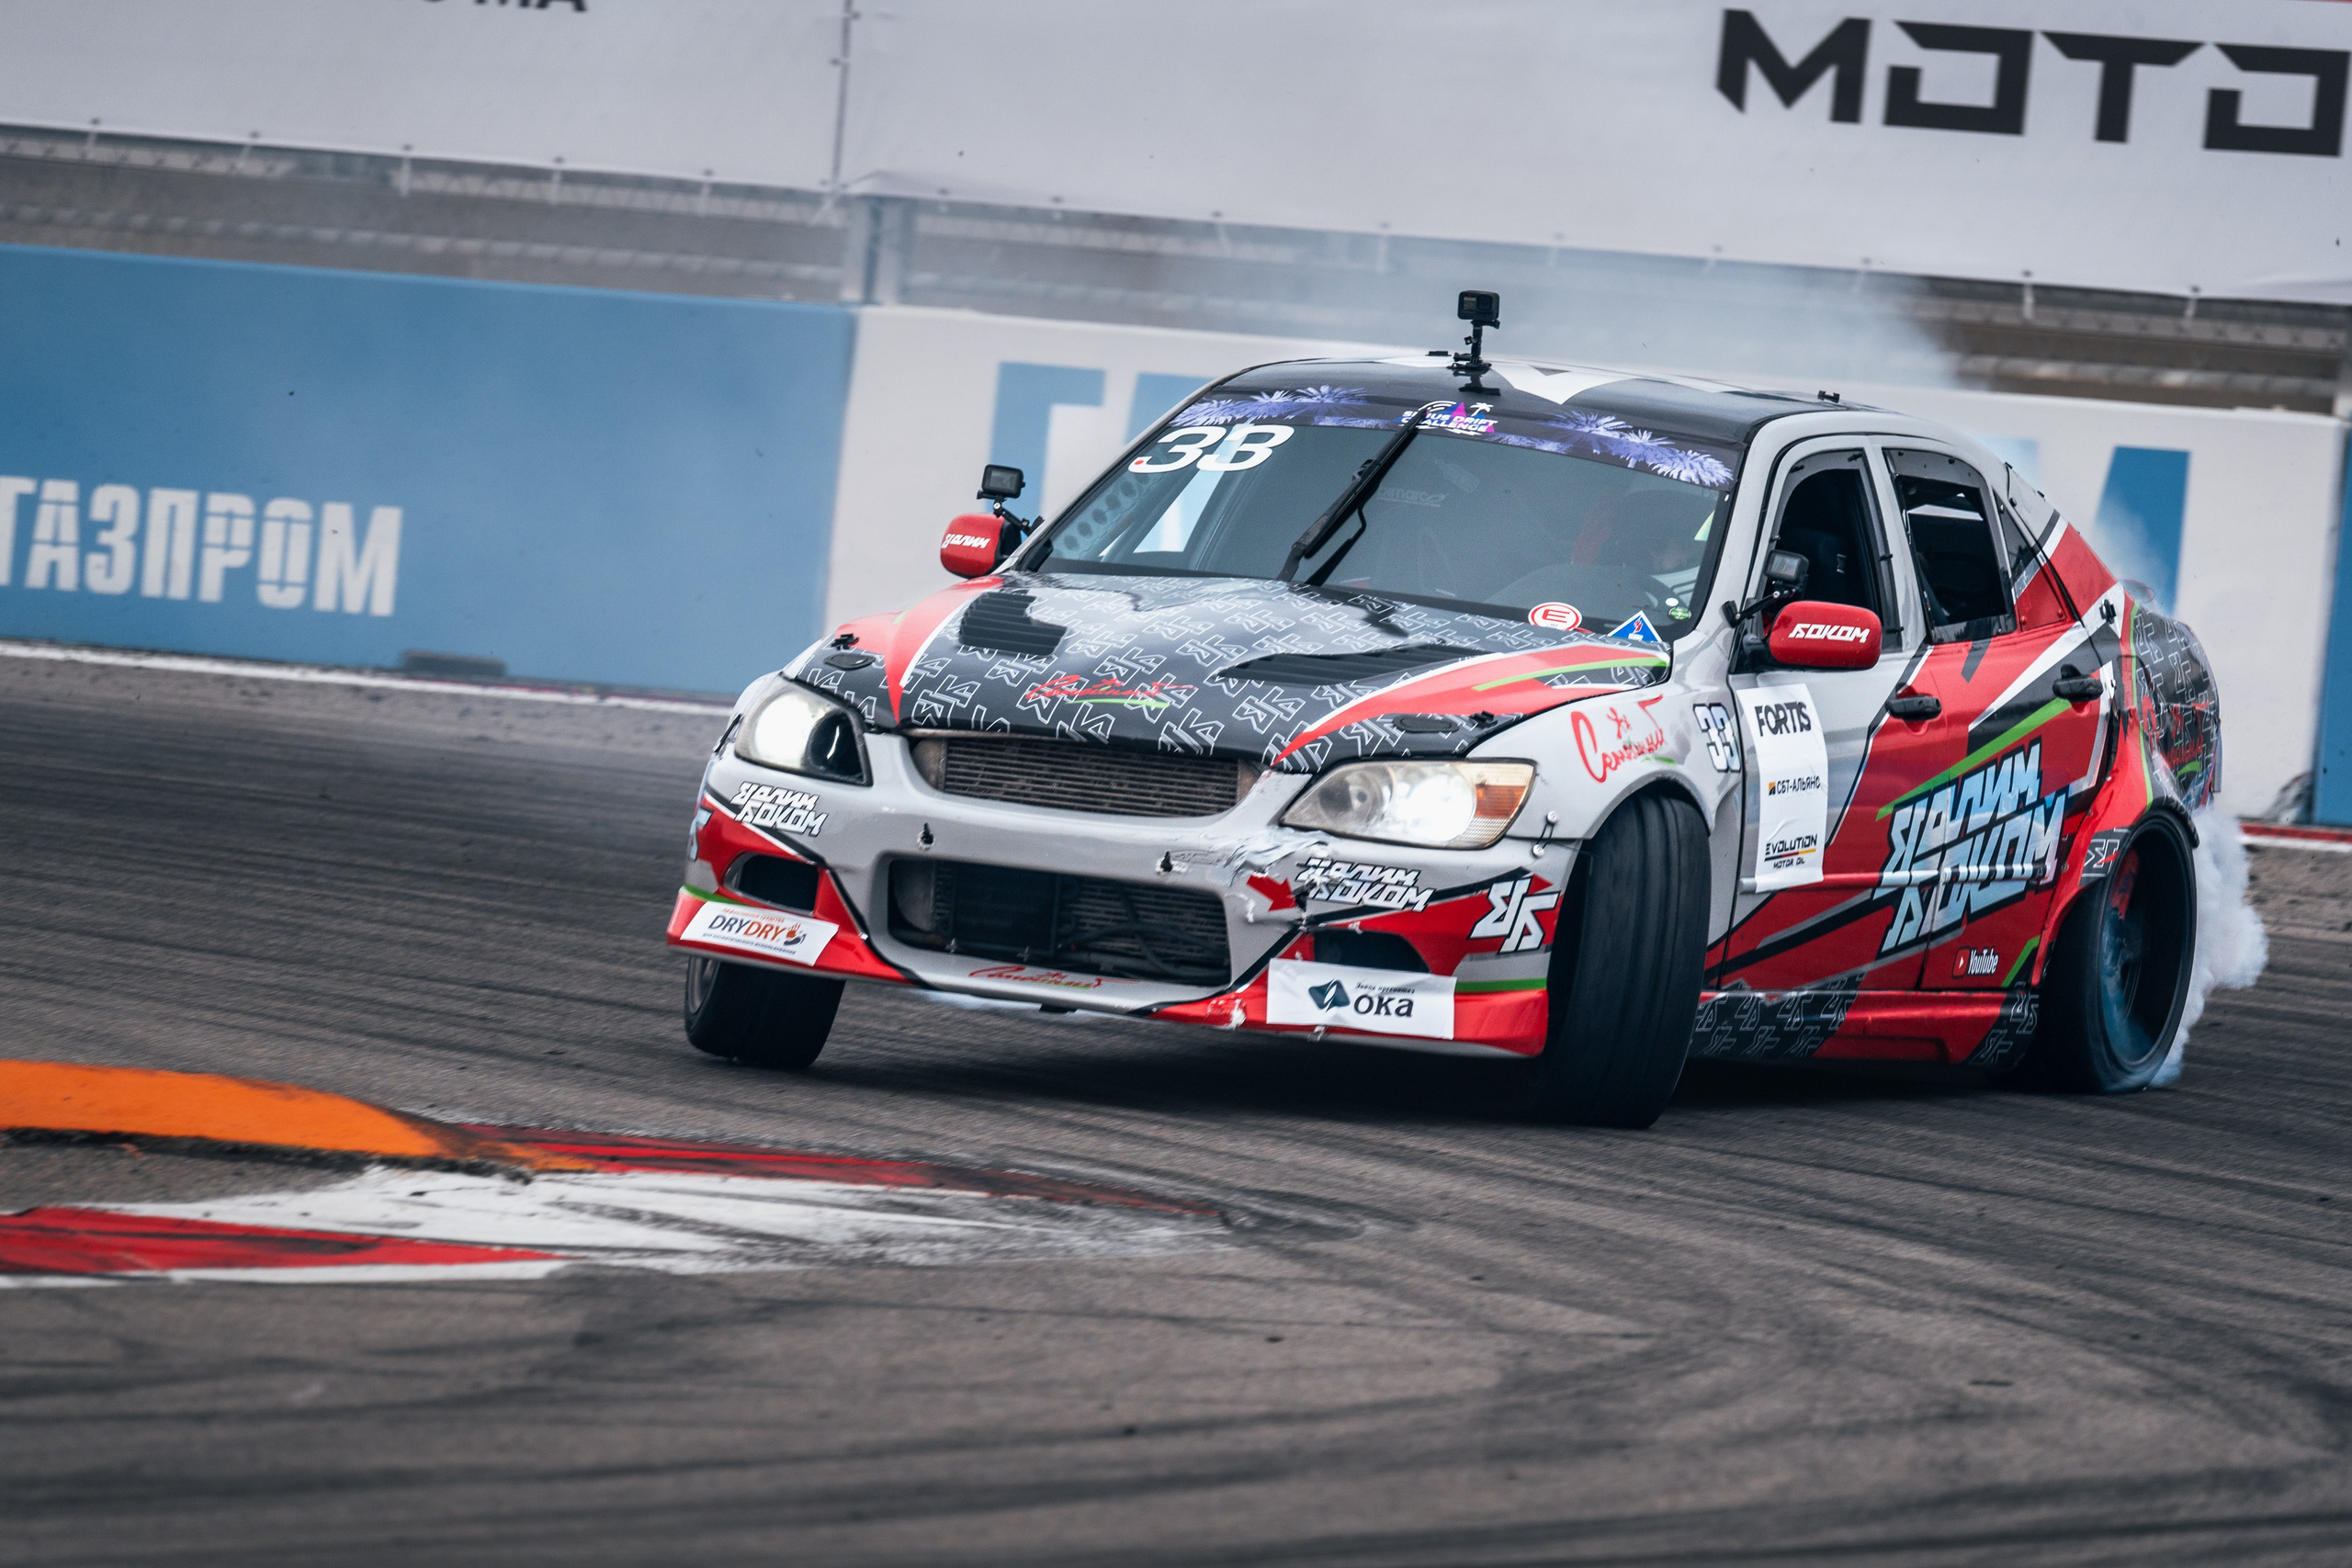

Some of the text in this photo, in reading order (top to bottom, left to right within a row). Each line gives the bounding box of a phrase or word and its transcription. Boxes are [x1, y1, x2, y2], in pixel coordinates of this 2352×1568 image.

[1400, 417, 1488, 433] CALLENGE
[0, 476, 402, 616] ГАЗПРОМ
[1755, 701, 1812, 737] FORTIS
[1693, 703, 1741, 773] 33
[1765, 834, 1818, 856] EVOLUTION
[1773, 857, 1805, 869] MOTOR OIL
[708, 915, 787, 942] DRYDRY
[1968, 947, 1999, 975] YouTube
